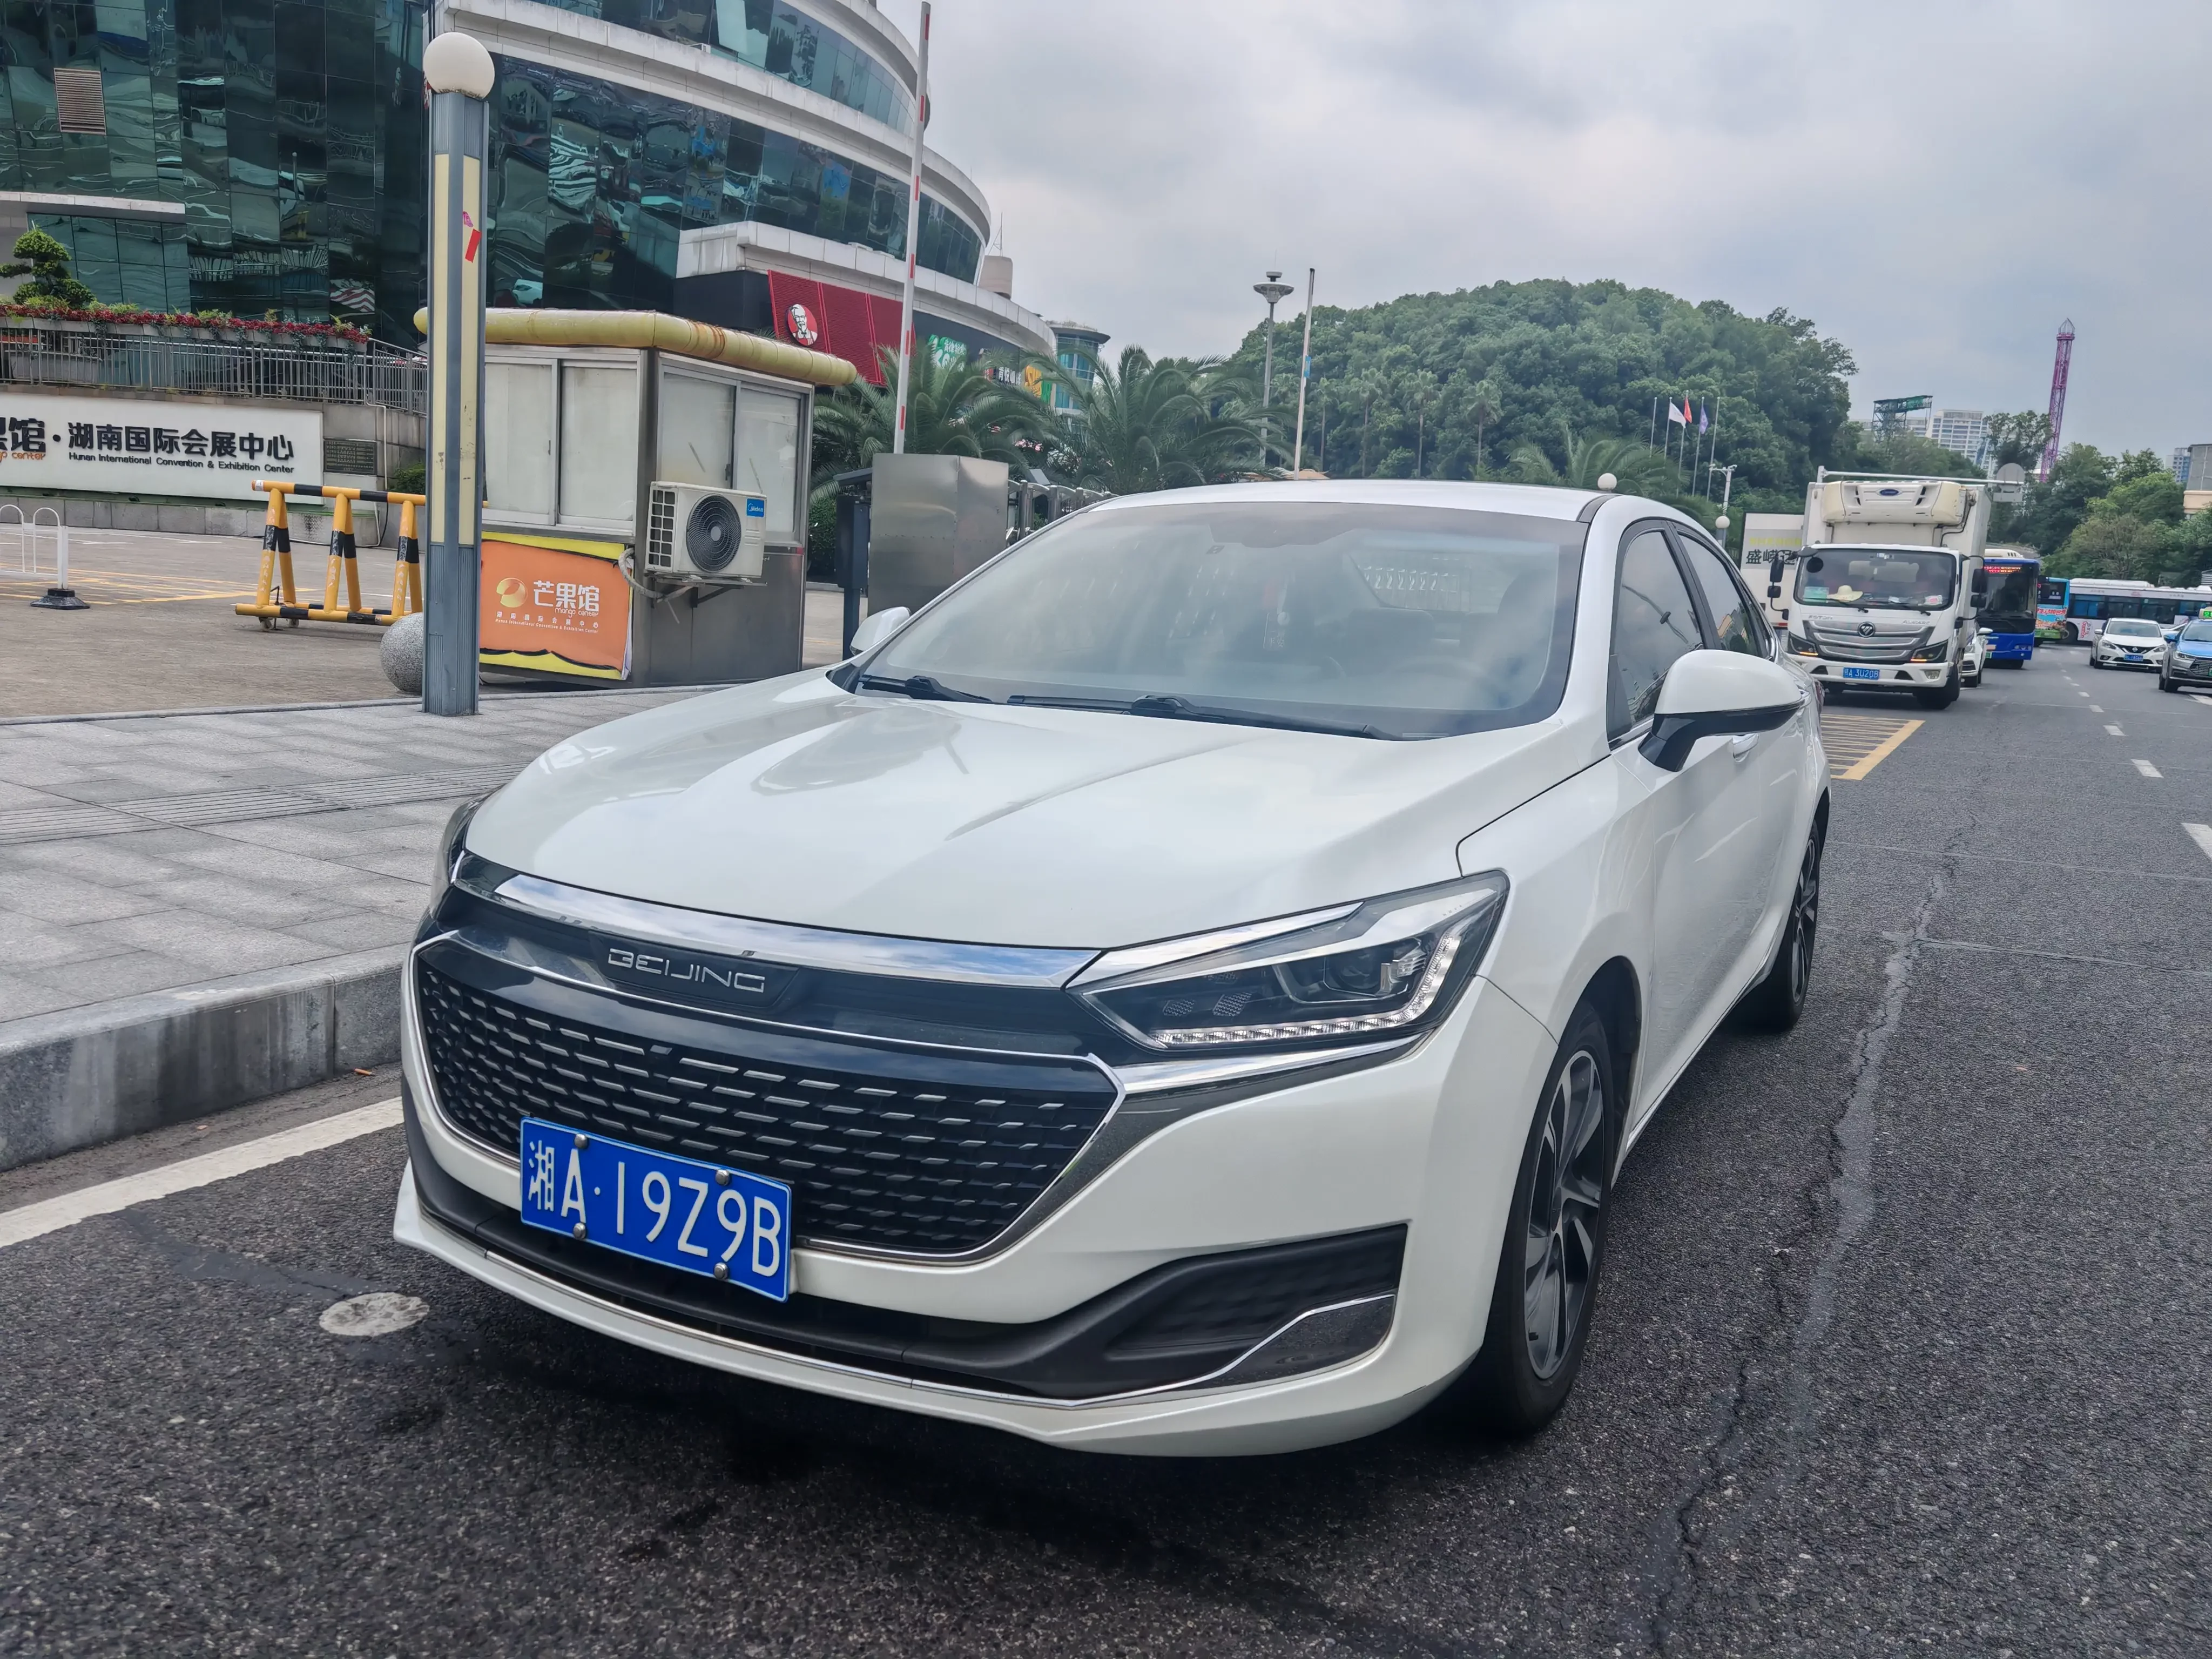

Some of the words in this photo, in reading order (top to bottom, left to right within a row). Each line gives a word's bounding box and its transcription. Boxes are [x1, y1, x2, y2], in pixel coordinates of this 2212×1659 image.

[69, 452, 96, 461] Hunan
[98, 454, 152, 464] International
[156, 457, 203, 468] Convention
[207, 461, 214, 469] &
[218, 461, 260, 471] Exhibition
[264, 464, 294, 473] Center
[534, 580, 599, 612] 芒果馆
[555, 608, 576, 618] mango
[608, 947, 766, 993] BEIJING
[528, 1139, 781, 1278] 湘A·19Z9B
